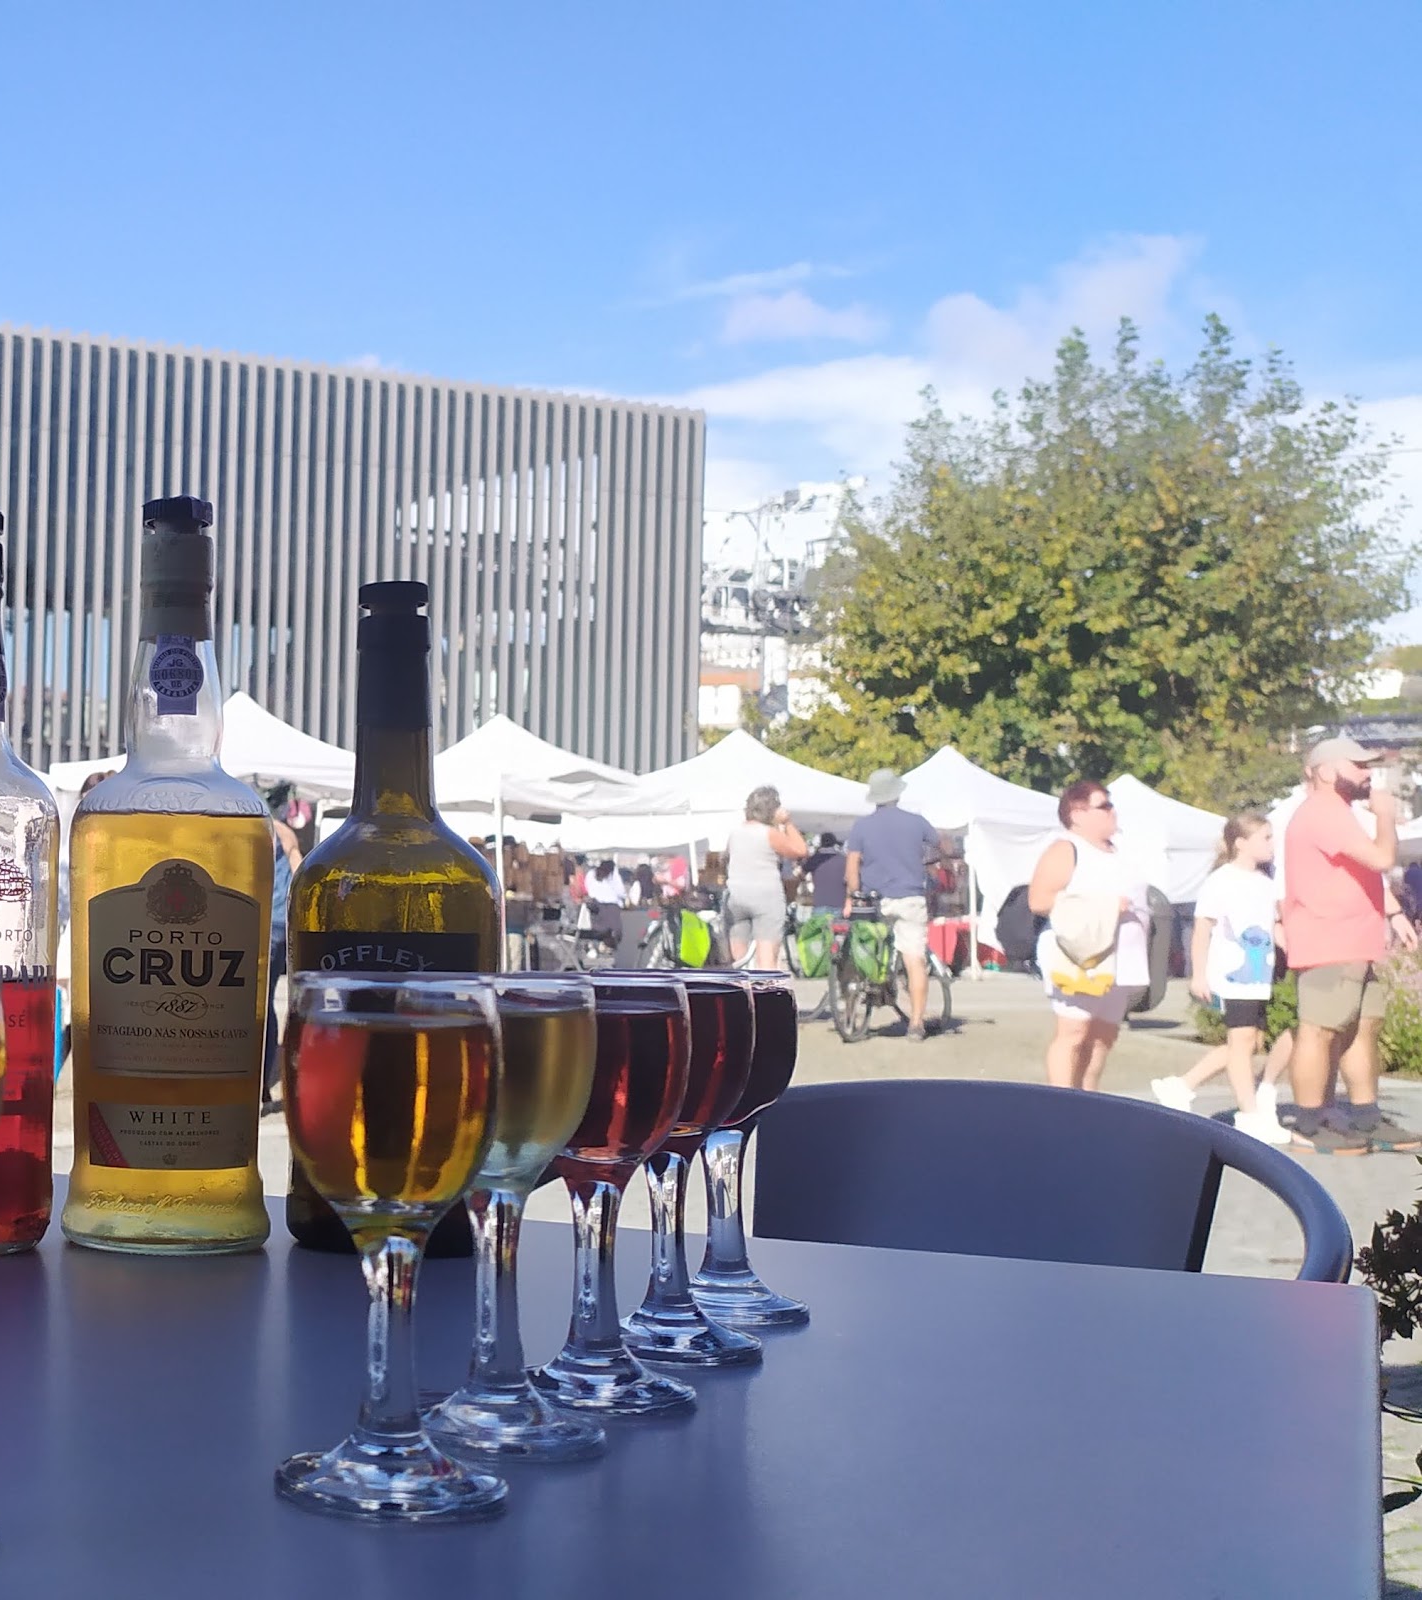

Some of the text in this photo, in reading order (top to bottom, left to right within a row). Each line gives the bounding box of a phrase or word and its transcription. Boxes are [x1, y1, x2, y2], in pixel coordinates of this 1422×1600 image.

[129, 929, 222, 945] PORTO
[320, 945, 435, 972] OFFLEY
[103, 947, 245, 987] CRUZ
[155, 999, 198, 1013] 1887
[8, 1009, 26, 1028] SÉ
[97, 1025, 248, 1039] ESTAGIADO NAS NOSSAS CAVES
[128, 1111, 212, 1124] WHITE
